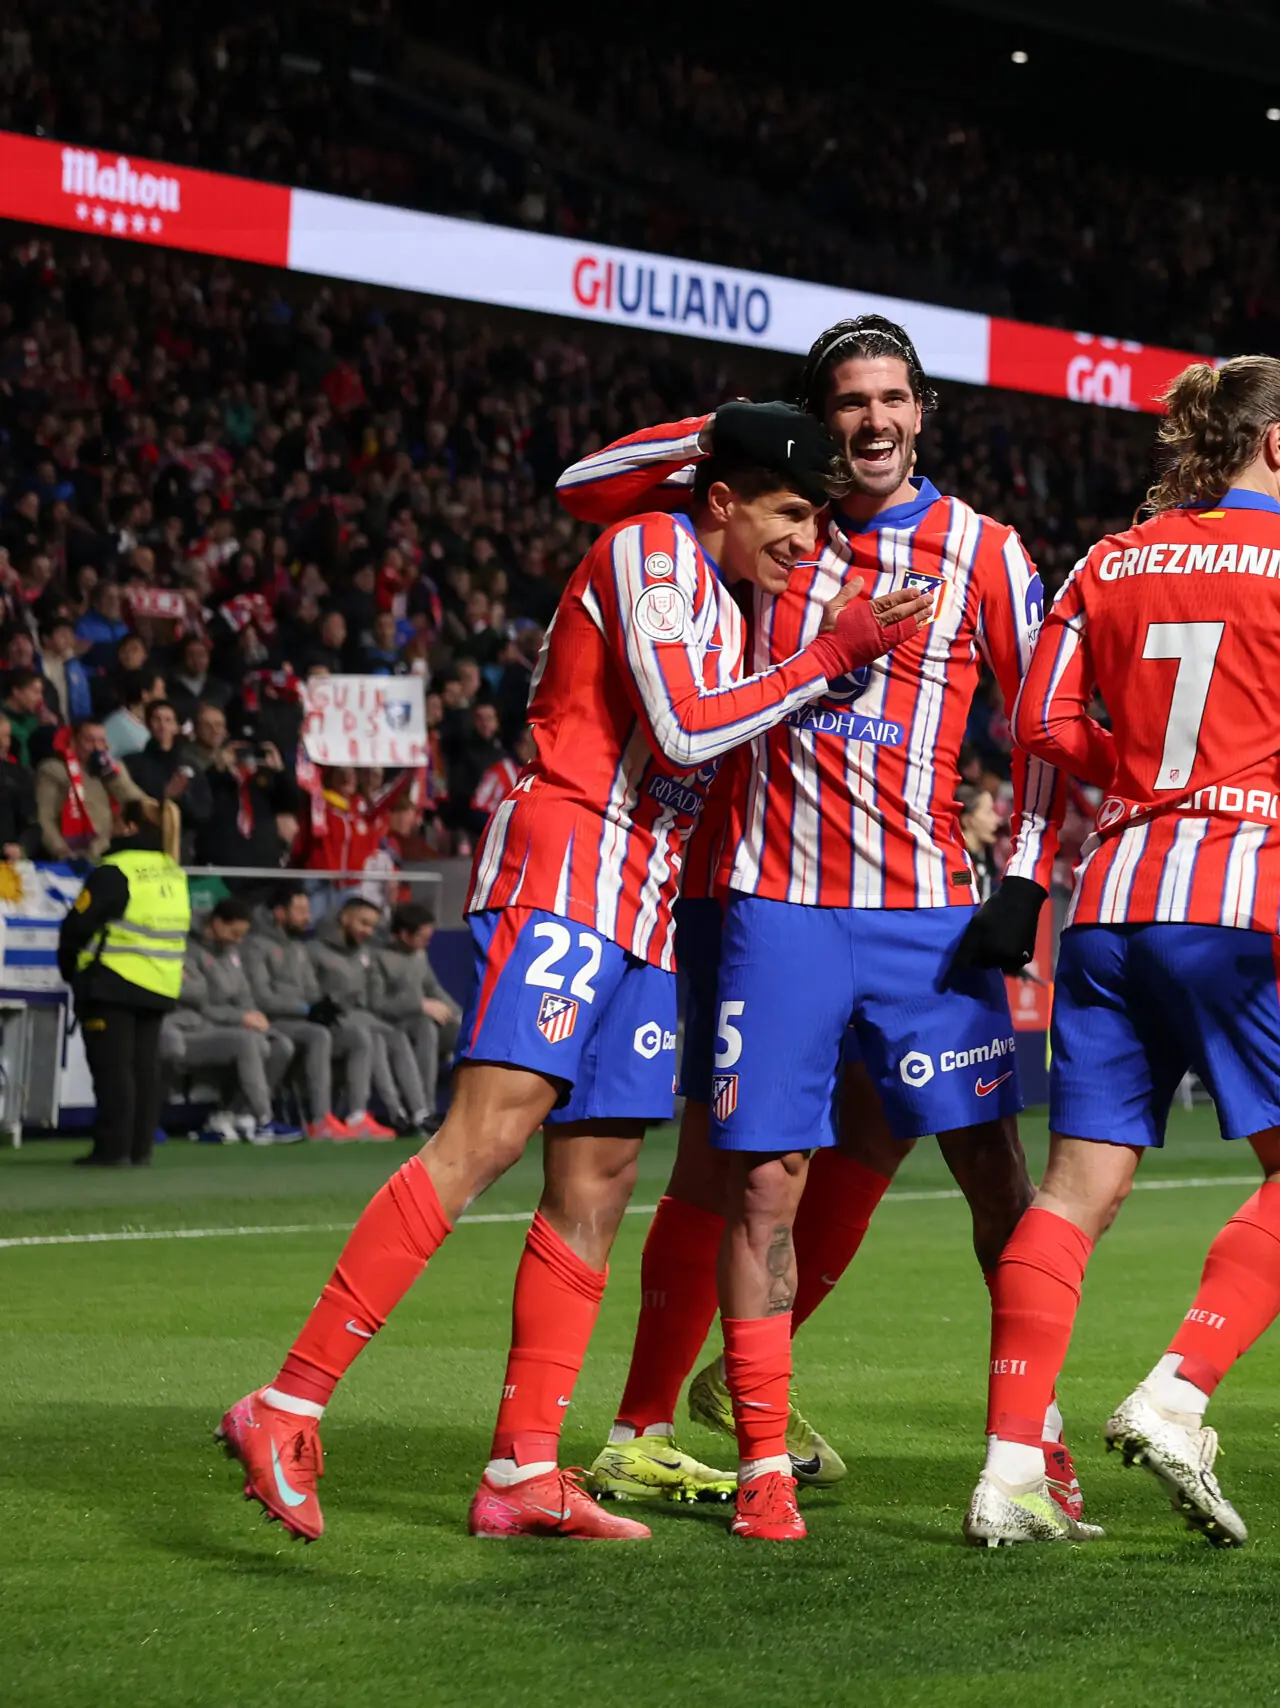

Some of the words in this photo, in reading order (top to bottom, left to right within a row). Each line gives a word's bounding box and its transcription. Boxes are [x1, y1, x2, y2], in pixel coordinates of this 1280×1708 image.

[572, 256, 770, 335] GIULIANO
[785, 706, 856, 736] YADH
[858, 720, 900, 745] AIR
[1141, 621, 1226, 791] 7
[525, 922, 602, 1005] 22
[714, 1000, 745, 1069] 5
[940, 1037, 1016, 1072] ComAve
